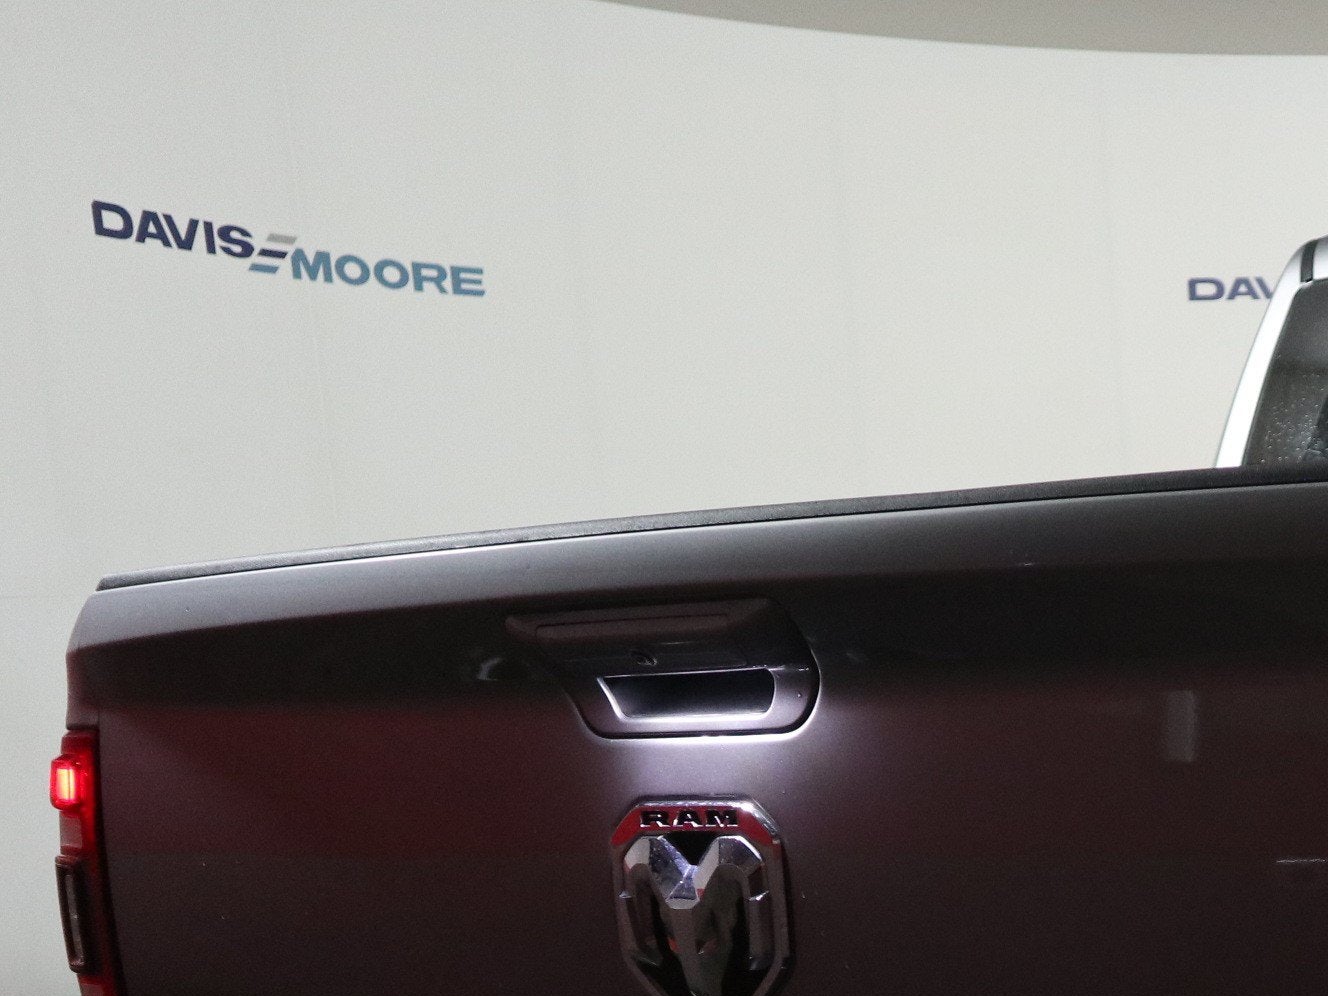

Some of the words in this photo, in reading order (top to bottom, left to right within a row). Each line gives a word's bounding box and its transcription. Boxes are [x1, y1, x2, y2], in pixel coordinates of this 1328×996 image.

[91, 199, 255, 259] DAVIS
[290, 247, 486, 297] MOORE
[640, 809, 738, 828] RAM
